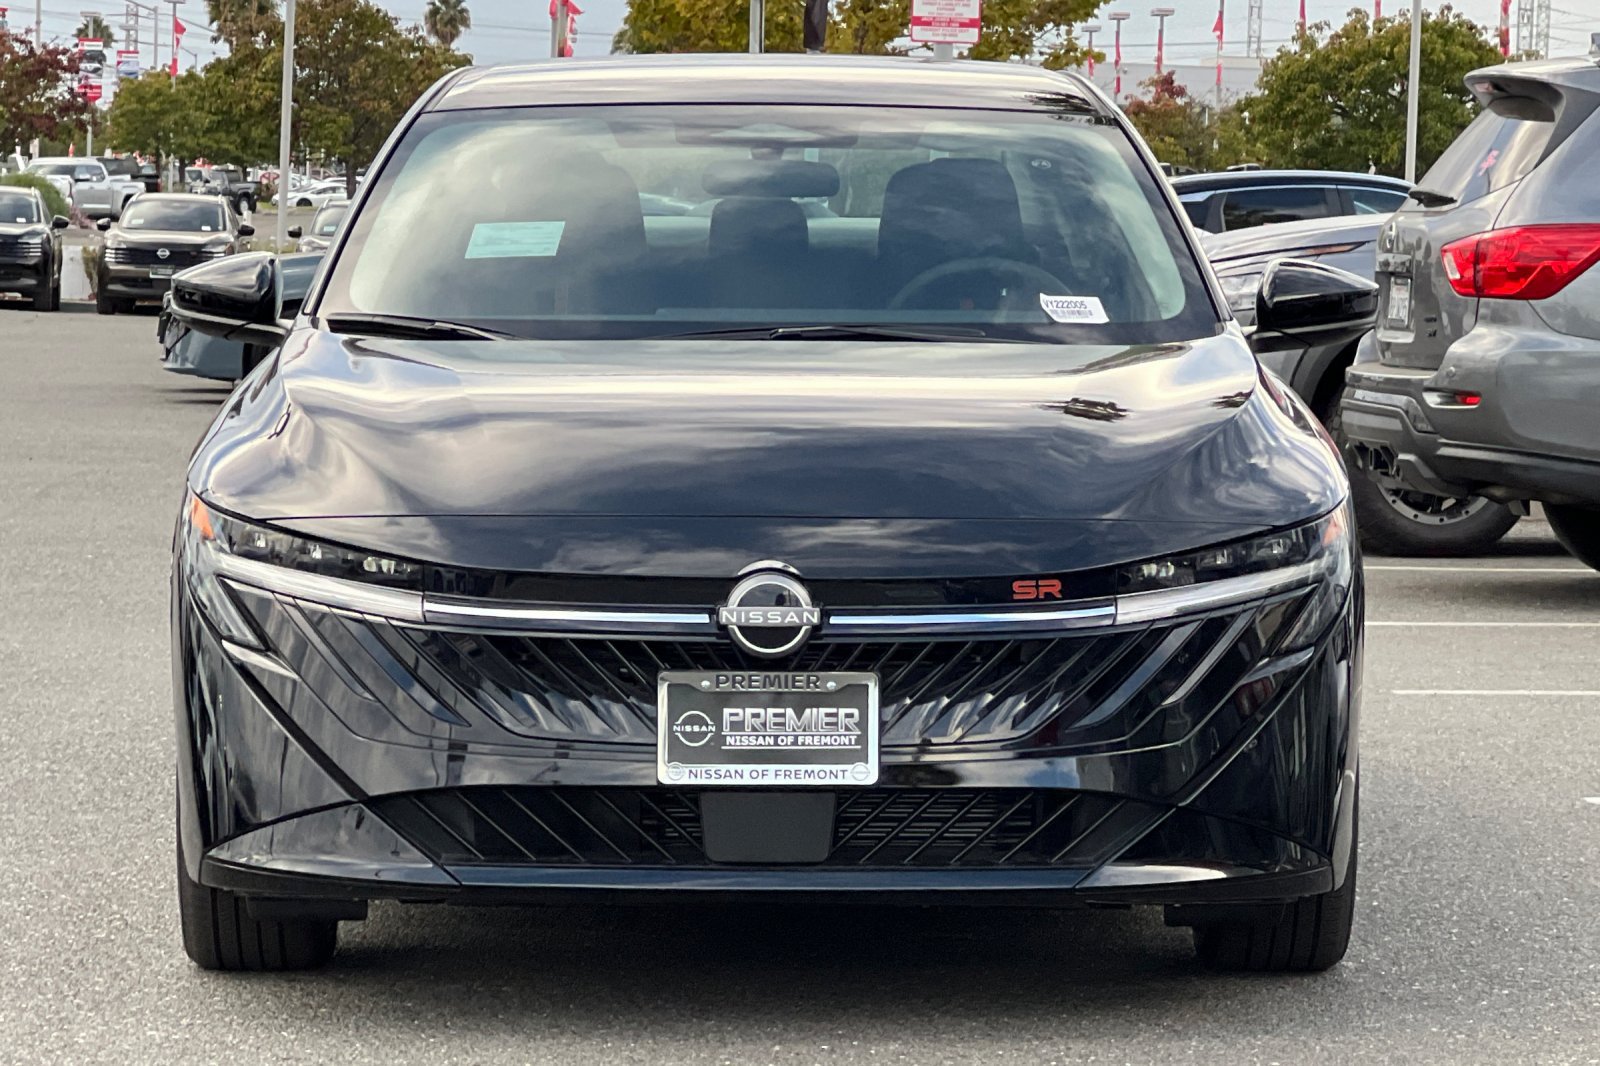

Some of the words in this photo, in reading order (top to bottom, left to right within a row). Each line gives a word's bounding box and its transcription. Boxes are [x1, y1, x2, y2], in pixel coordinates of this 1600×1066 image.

[1012, 579, 1062, 599] SR
[721, 611, 819, 624] NISSAN
[715, 674, 821, 691] PREMIER
[722, 707, 861, 732] PREMIER
[672, 724, 716, 732] NISSAN
[726, 735, 774, 746] NISSAN
[777, 735, 795, 746] OF
[797, 735, 857, 746] FREMONT
[688, 769, 744, 780] NISSAN
[749, 769, 769, 780] OF
[774, 769, 848, 780] FREMONT
